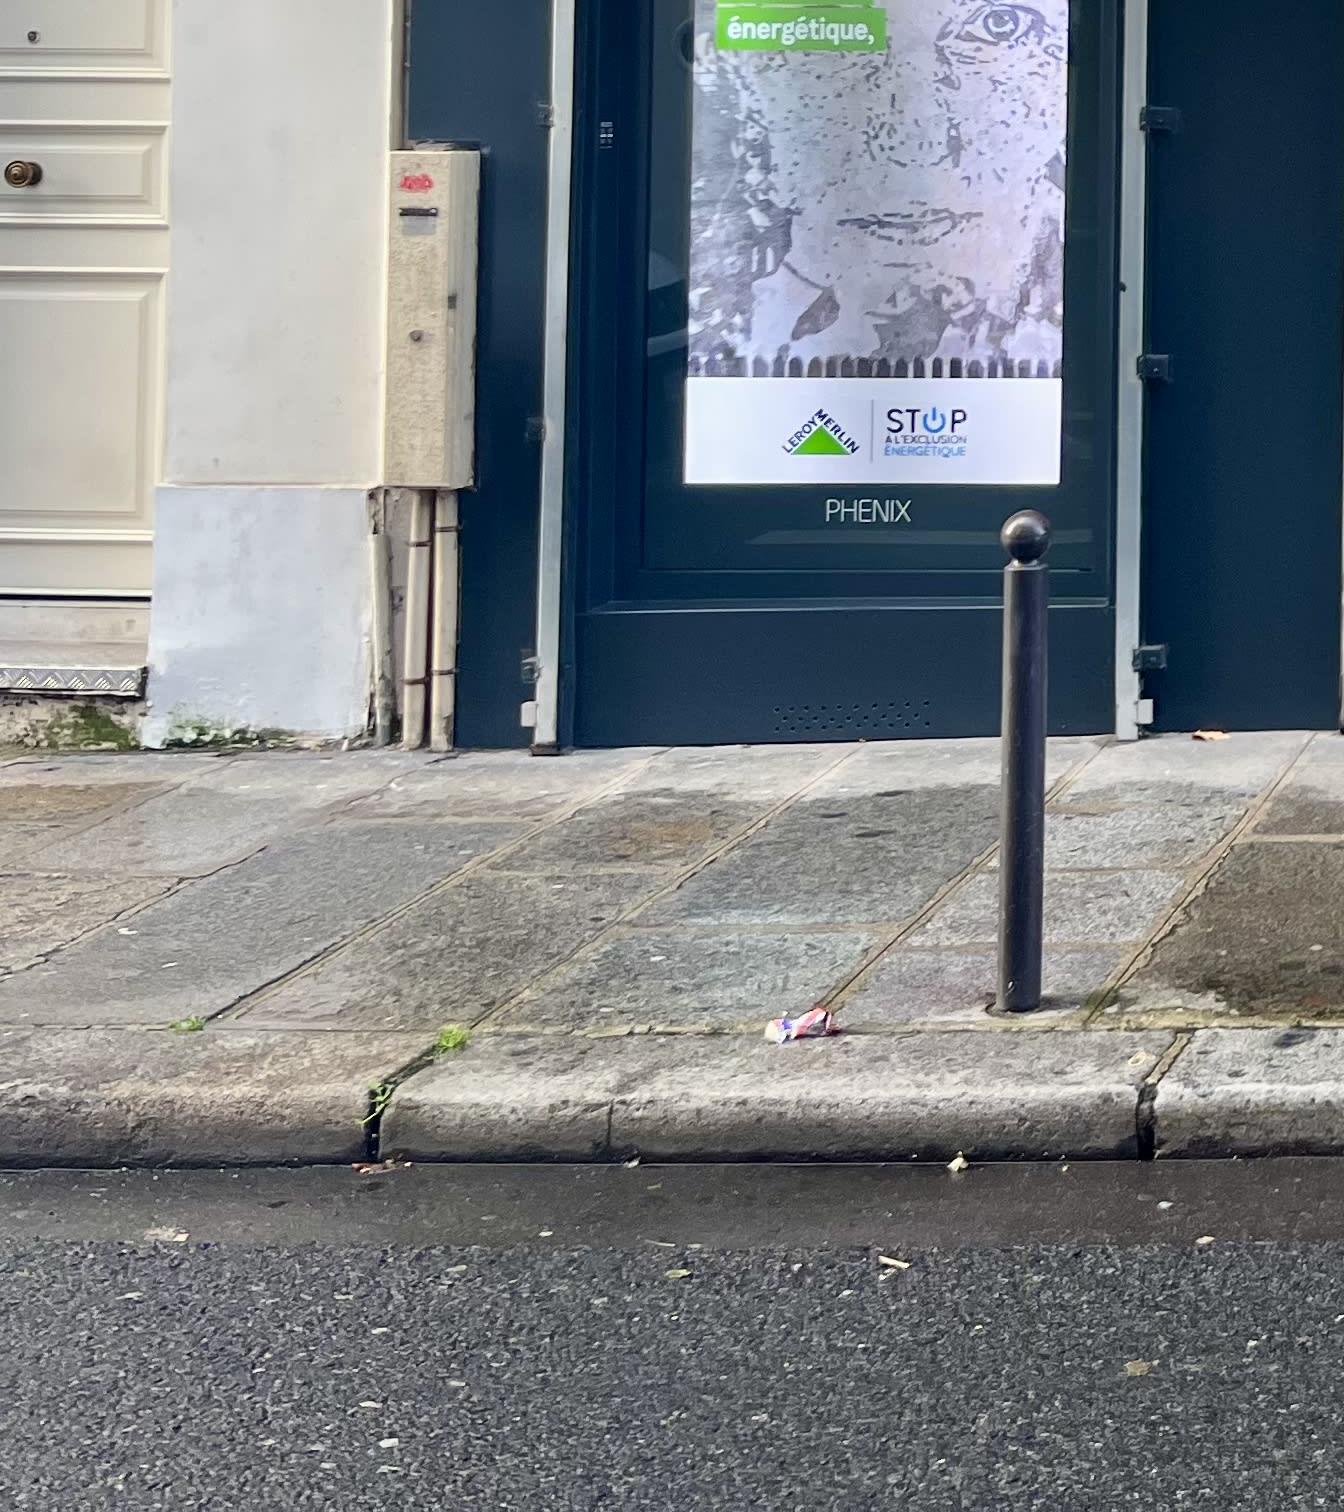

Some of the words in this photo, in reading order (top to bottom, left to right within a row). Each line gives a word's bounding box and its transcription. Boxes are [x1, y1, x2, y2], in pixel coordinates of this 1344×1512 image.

[727, 15, 875, 45] énergétique,
[781, 416, 818, 454] LEROY
[814, 408, 860, 455] MERLIN
[886, 407, 967, 434] STOP
[826, 499, 911, 523] PHENIX
